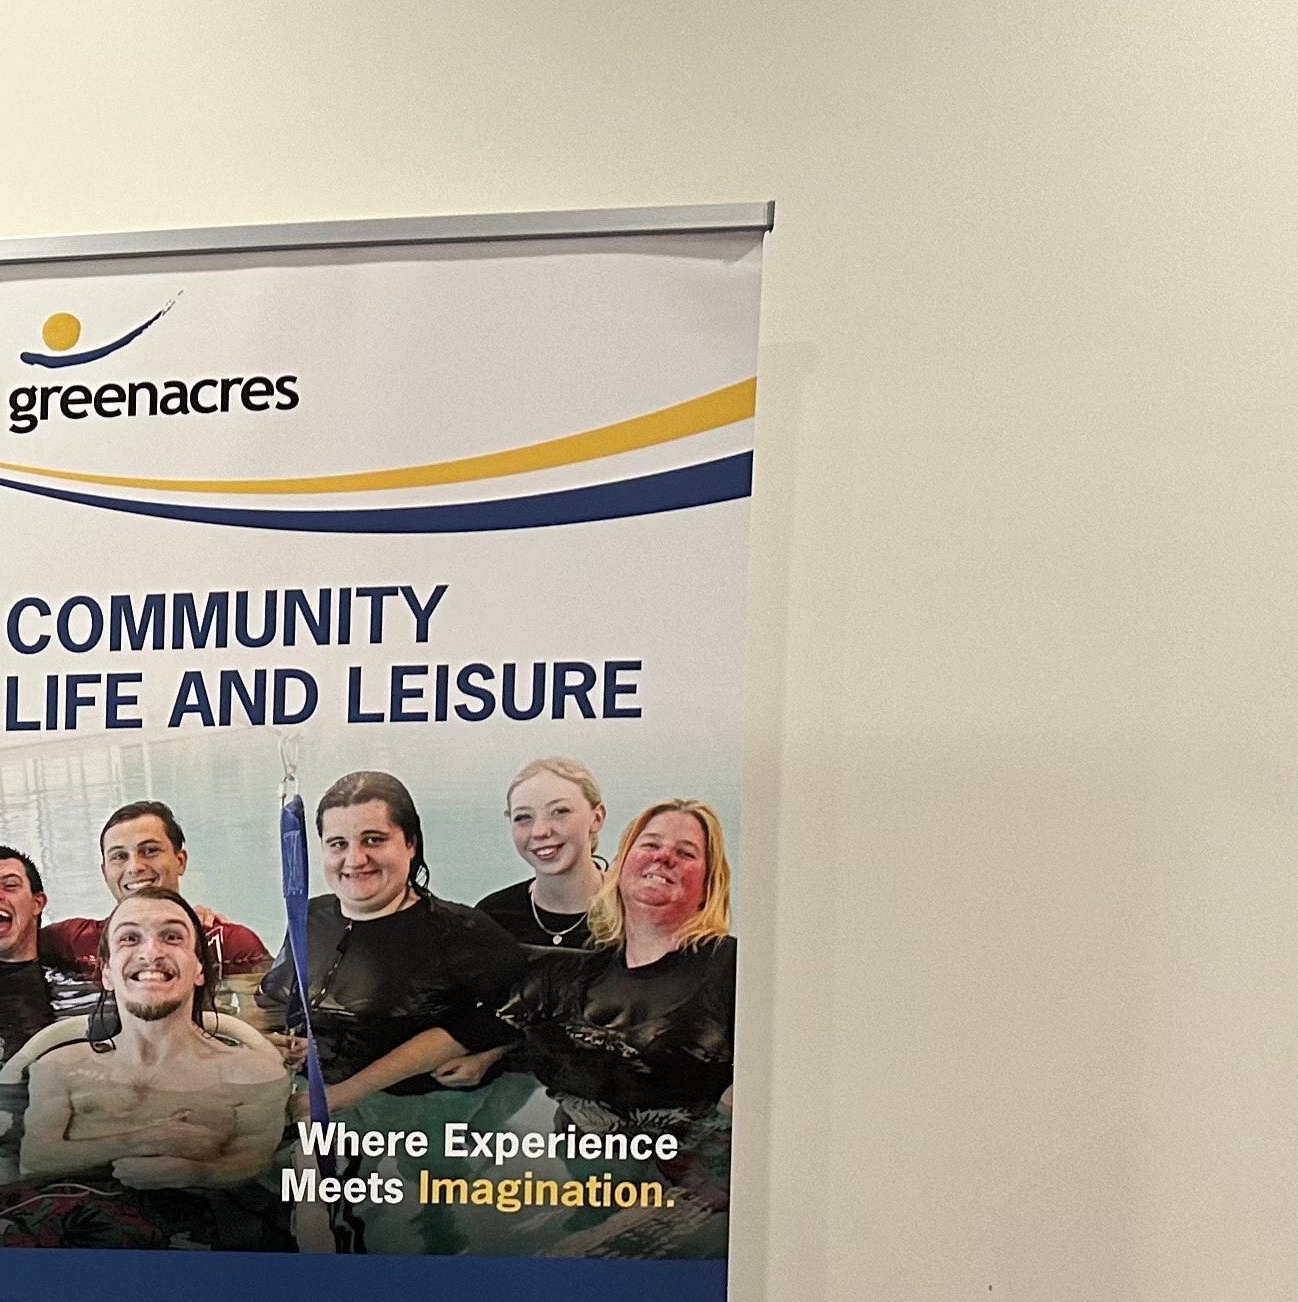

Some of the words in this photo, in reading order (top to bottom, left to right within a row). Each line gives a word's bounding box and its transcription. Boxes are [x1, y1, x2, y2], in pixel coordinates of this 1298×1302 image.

[7, 374, 299, 433] greenacres
[6, 585, 448, 655] COMMUNITY
[5, 672, 144, 732] LIFE
[168, 668, 319, 729] AND
[347, 660, 643, 724] LEISURE
[297, 1120, 429, 1159] Where
[443, 1122, 679, 1165] Experience
[281, 1167, 404, 1205] Meets
[418, 1168, 677, 1211] Imagination.
